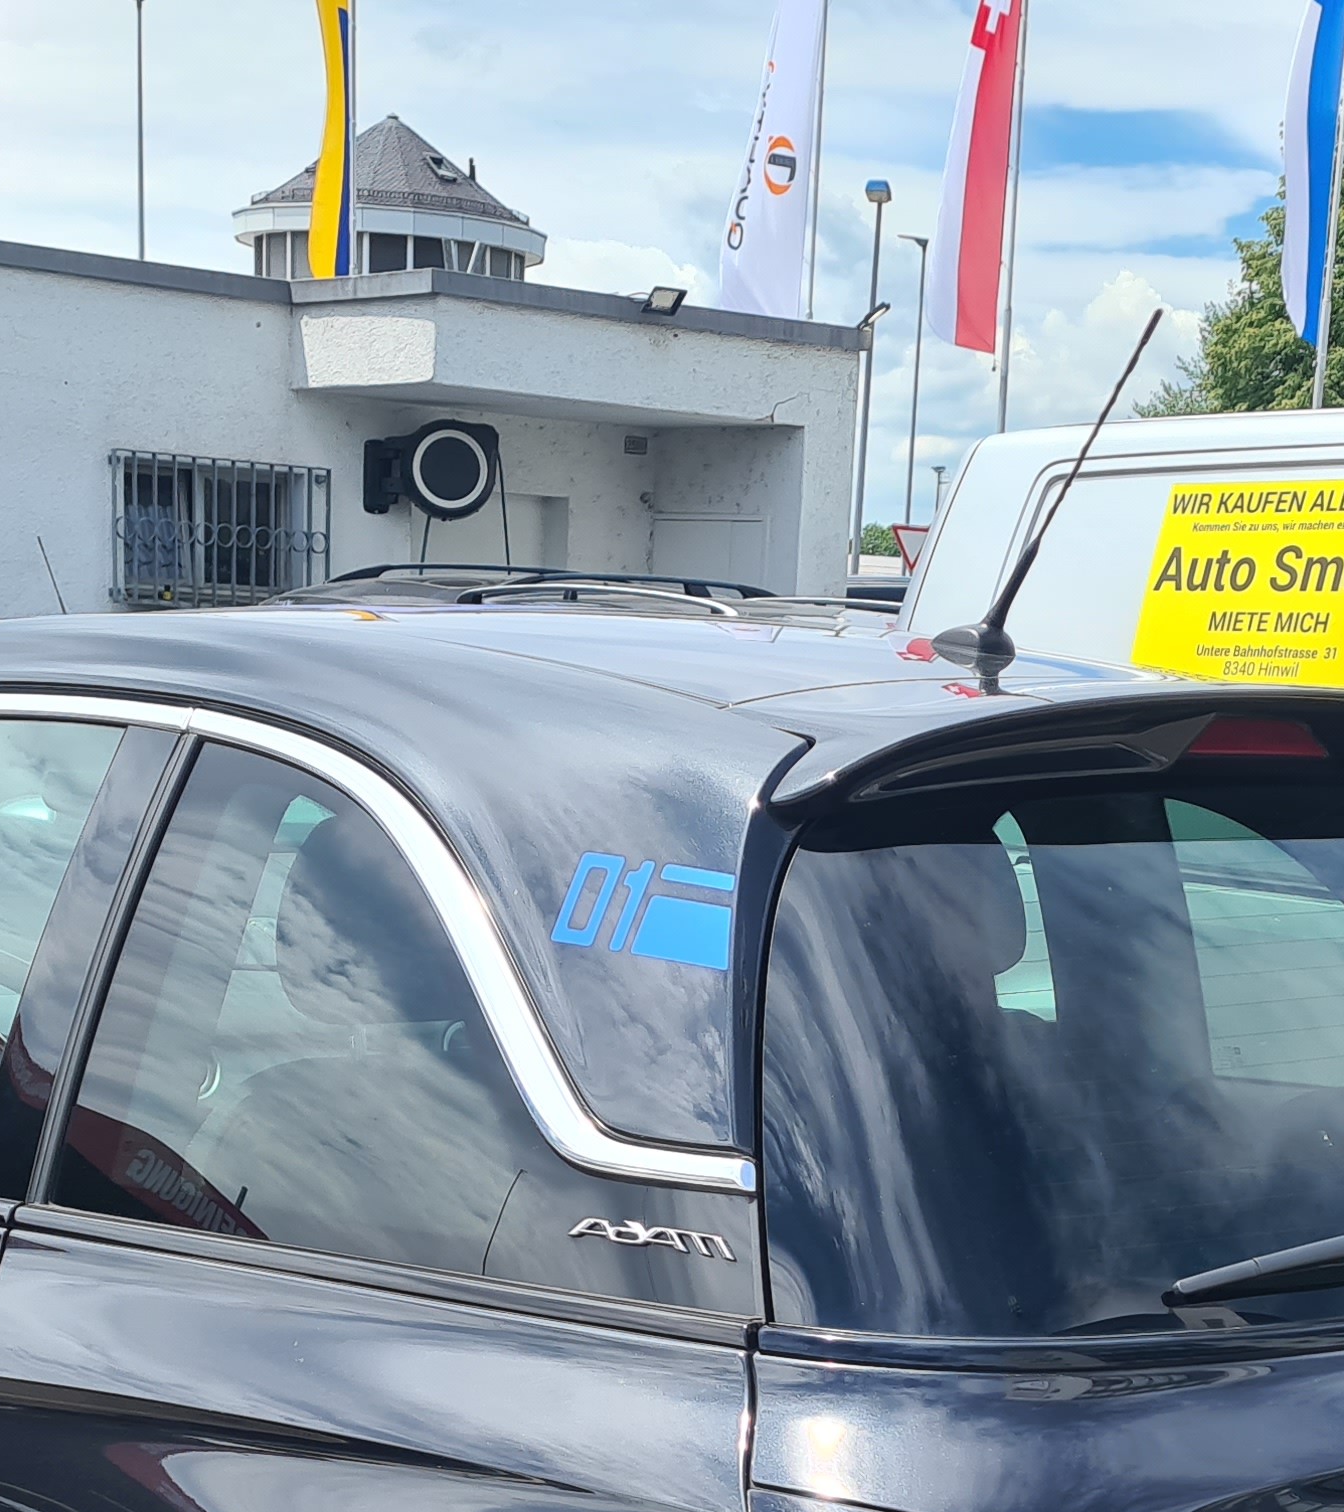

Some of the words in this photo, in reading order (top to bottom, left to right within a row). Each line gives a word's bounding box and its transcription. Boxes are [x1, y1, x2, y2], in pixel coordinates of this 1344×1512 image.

[1172, 493, 1211, 515] WIR
[1216, 490, 1307, 514] KAUFEN
[1192, 521, 1230, 533] Kommen
[1232, 520, 1247, 532] Sie
[1248, 522, 1259, 532] zu
[1261, 522, 1280, 534] uns,
[1283, 520, 1295, 531] wir
[1298, 519, 1334, 531] machen
[1153, 546, 1256, 592] Auto
[1208, 611, 1271, 632] MIETE
[1273, 612, 1330, 633] MICH
[1196, 644, 1231, 658] Untere
[1233, 645, 1318, 660] Bahnhofstrasse
[1324, 647, 1337, 660] 31
[1223, 661, 1255, 677] 8340
[1258, 661, 1299, 678] Hinwil
